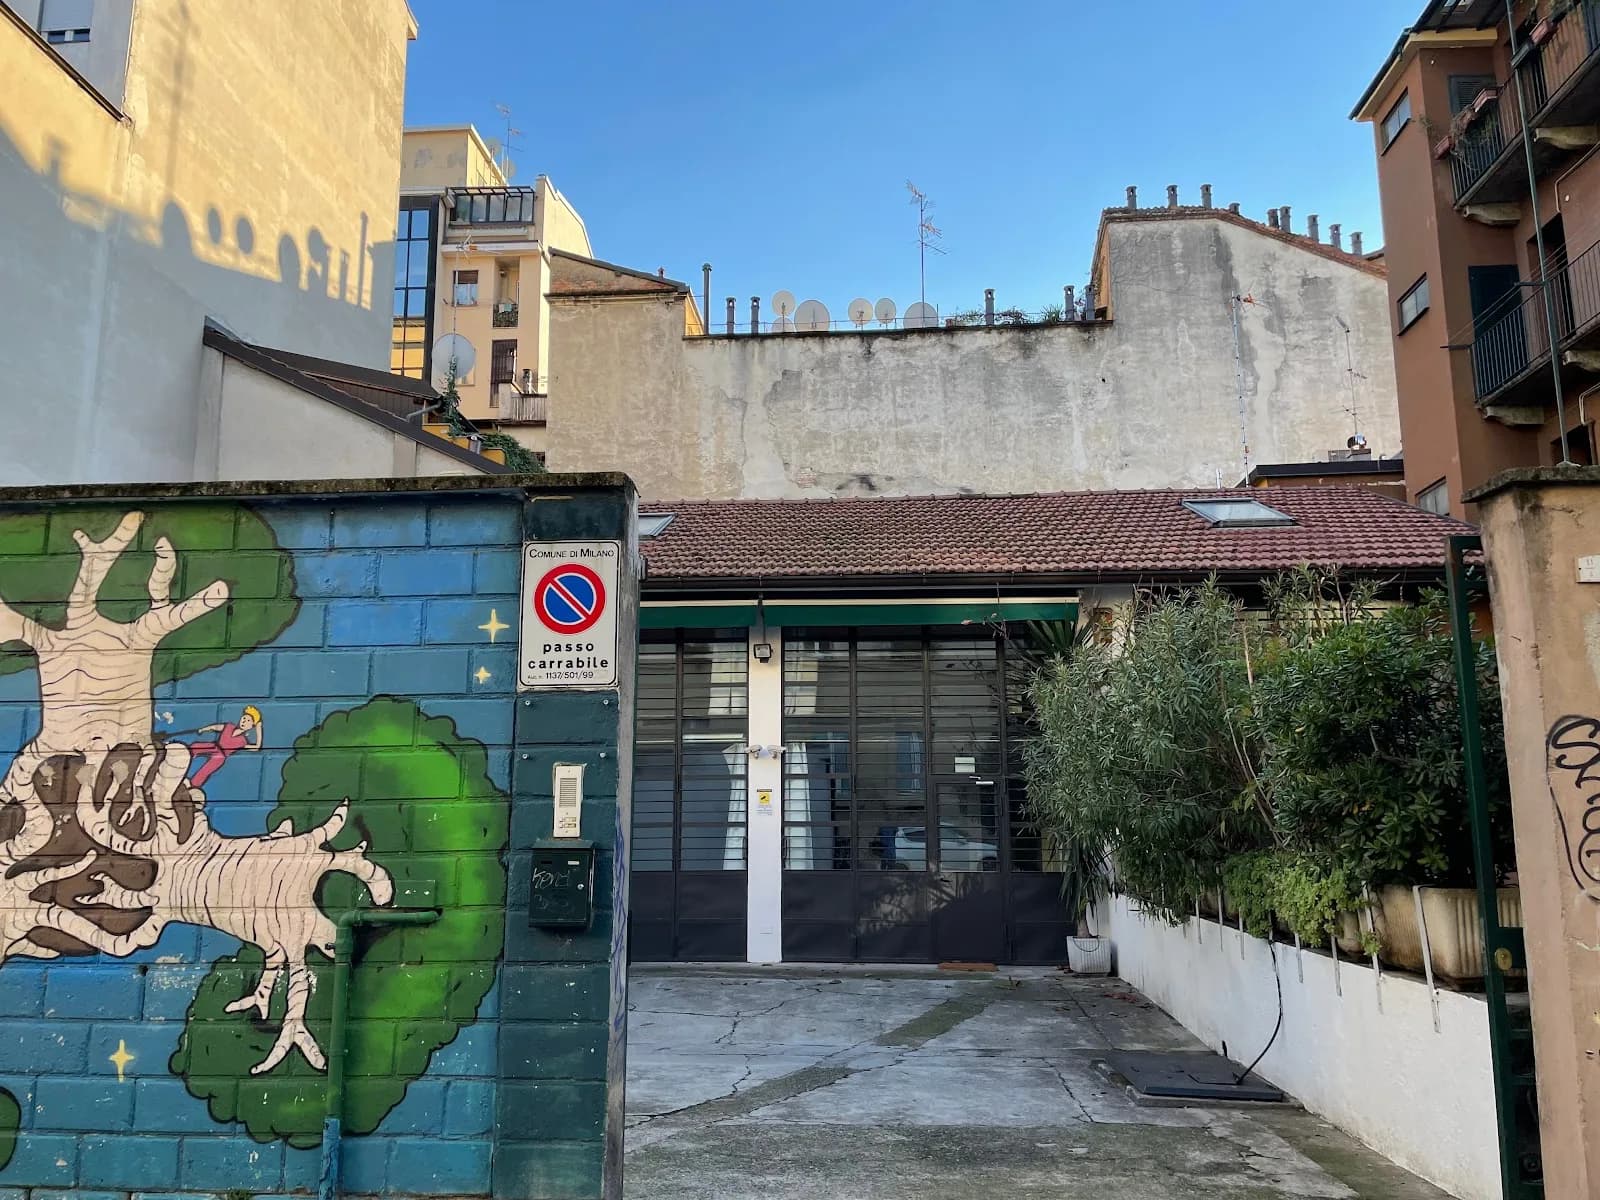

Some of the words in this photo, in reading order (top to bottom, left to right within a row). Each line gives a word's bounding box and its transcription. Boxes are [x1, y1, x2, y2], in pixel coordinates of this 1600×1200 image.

[543, 643, 593, 654] passo
[528, 656, 609, 669] carrabile
[545, 671, 593, 679] 1137/501/99
